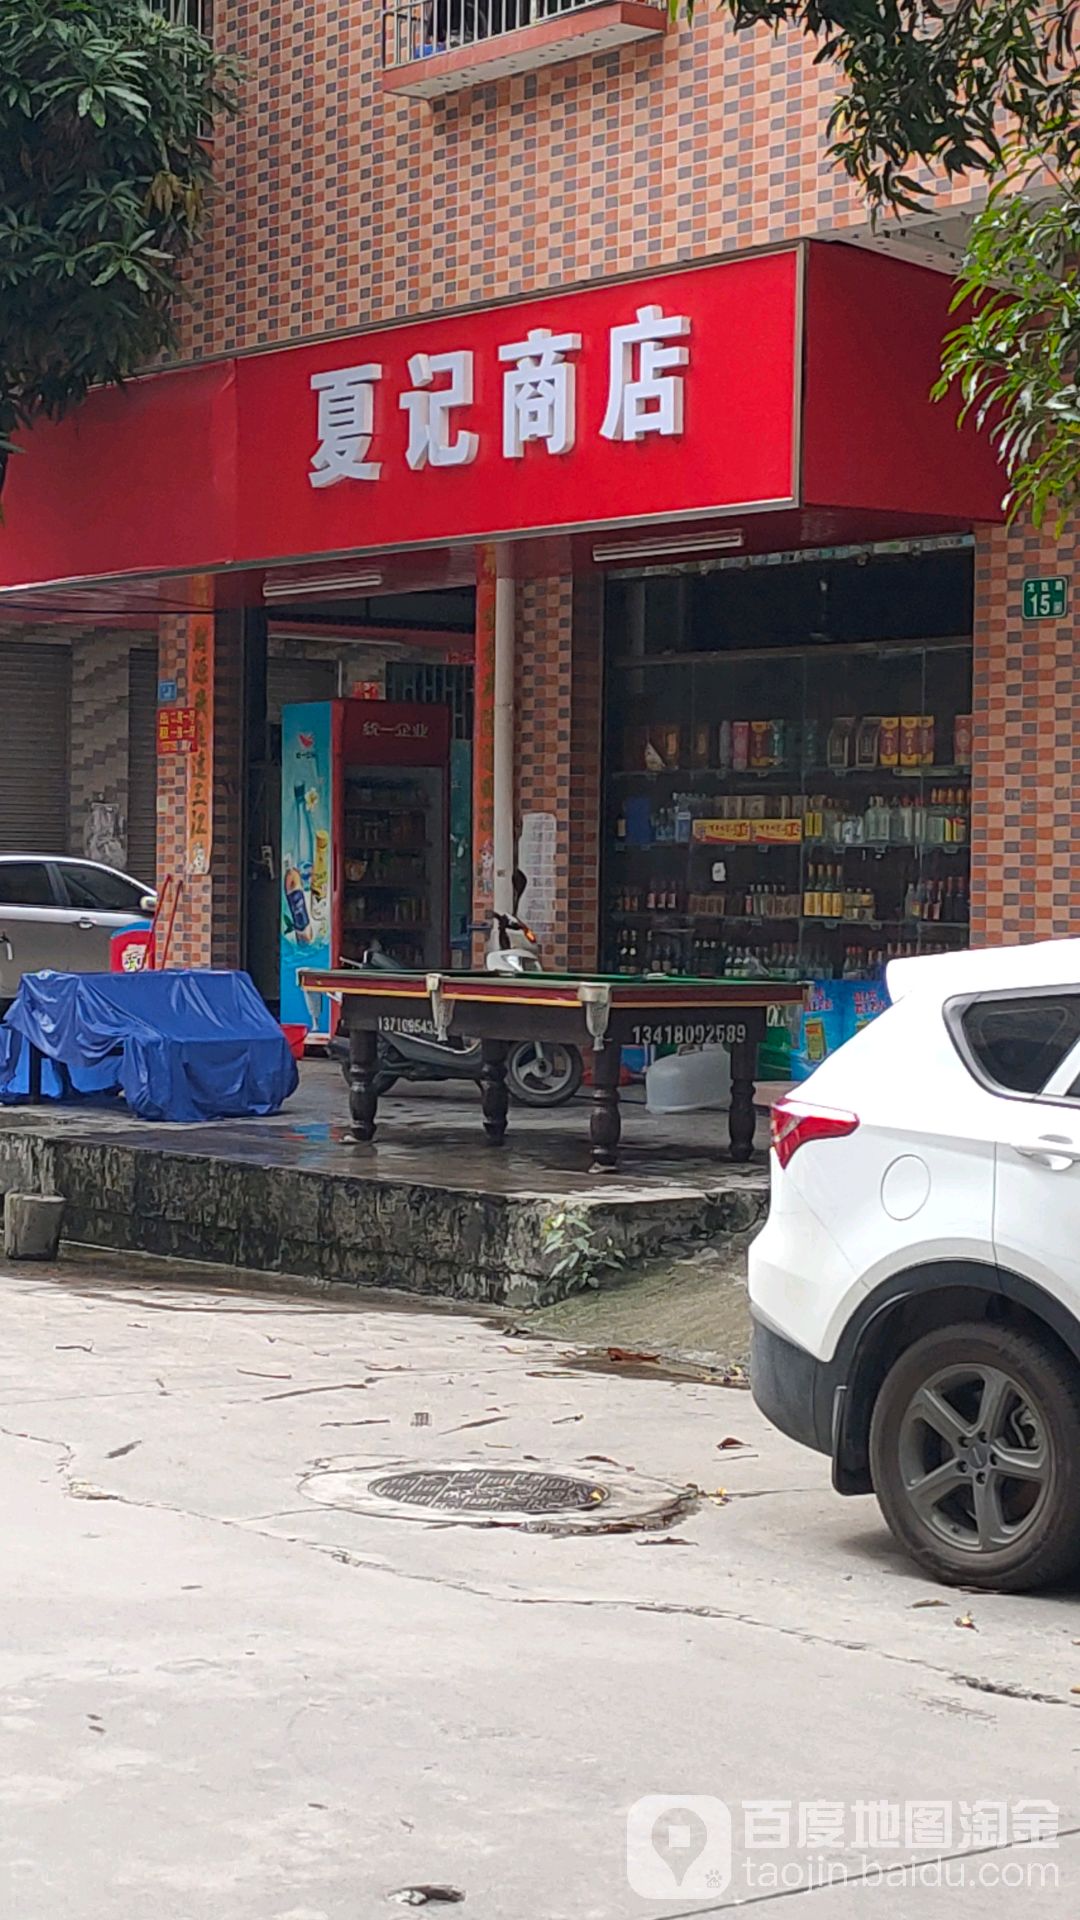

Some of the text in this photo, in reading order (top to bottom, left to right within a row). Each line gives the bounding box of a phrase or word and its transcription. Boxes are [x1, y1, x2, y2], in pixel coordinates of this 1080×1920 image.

[308, 304, 692, 489] 夏记商店
[362, 720, 429, 738] 统一企业
